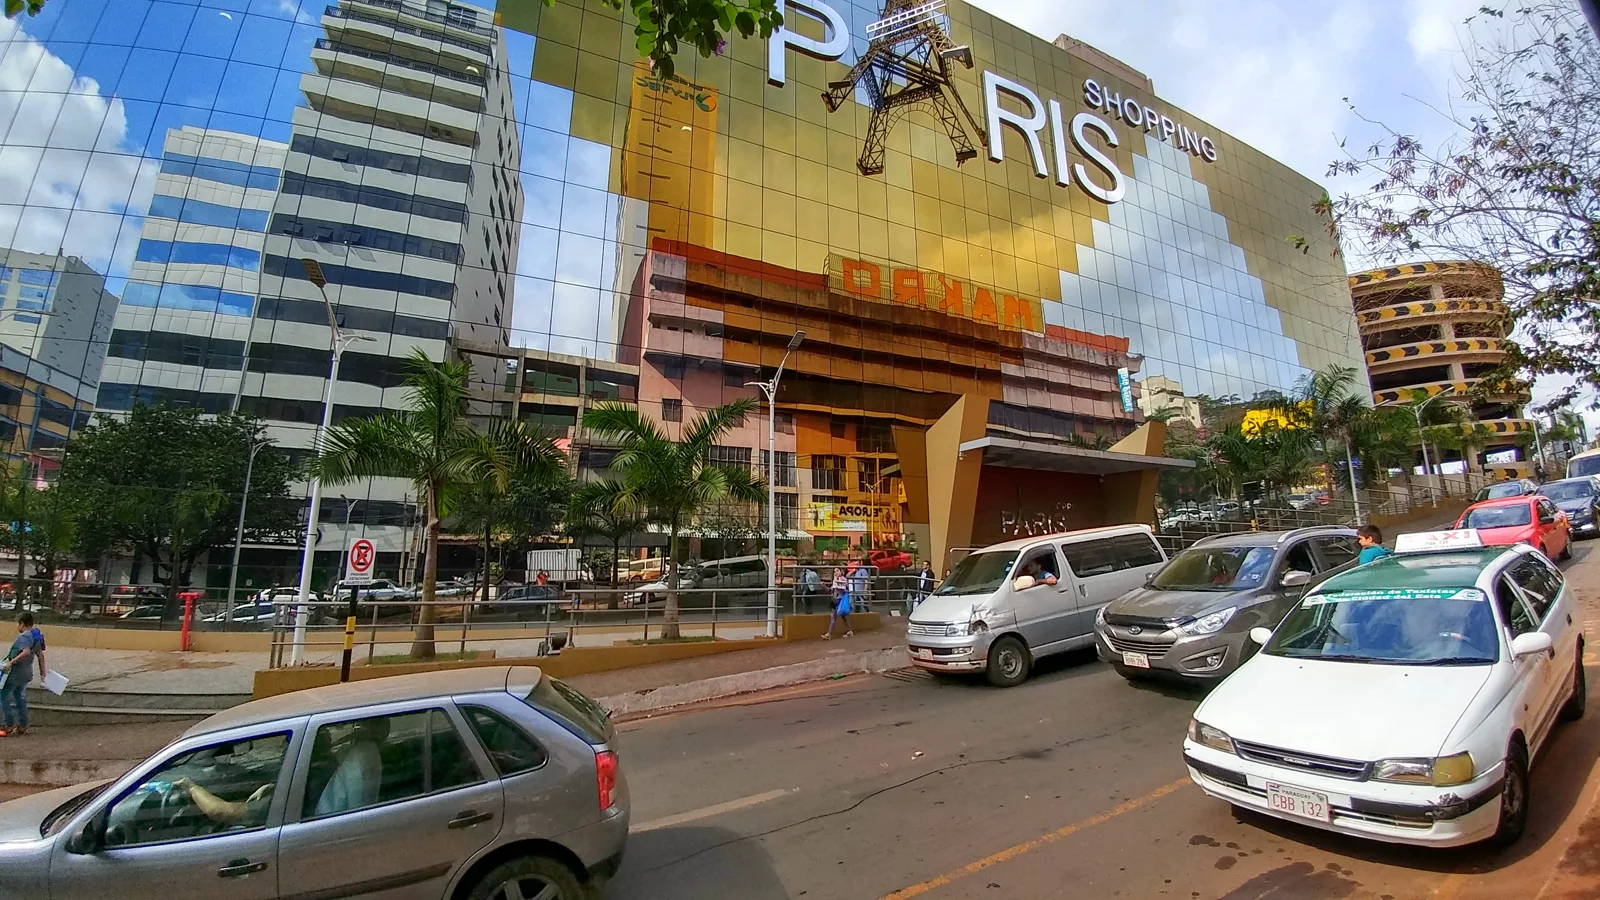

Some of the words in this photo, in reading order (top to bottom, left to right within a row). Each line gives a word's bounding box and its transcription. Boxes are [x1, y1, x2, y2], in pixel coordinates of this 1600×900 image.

[1082, 78, 1218, 163] SHOPPING
[1272, 793, 1296, 811] CBB
[1301, 800, 1324, 818] 132
[1282, 789, 1311, 800] PARAGUAY
